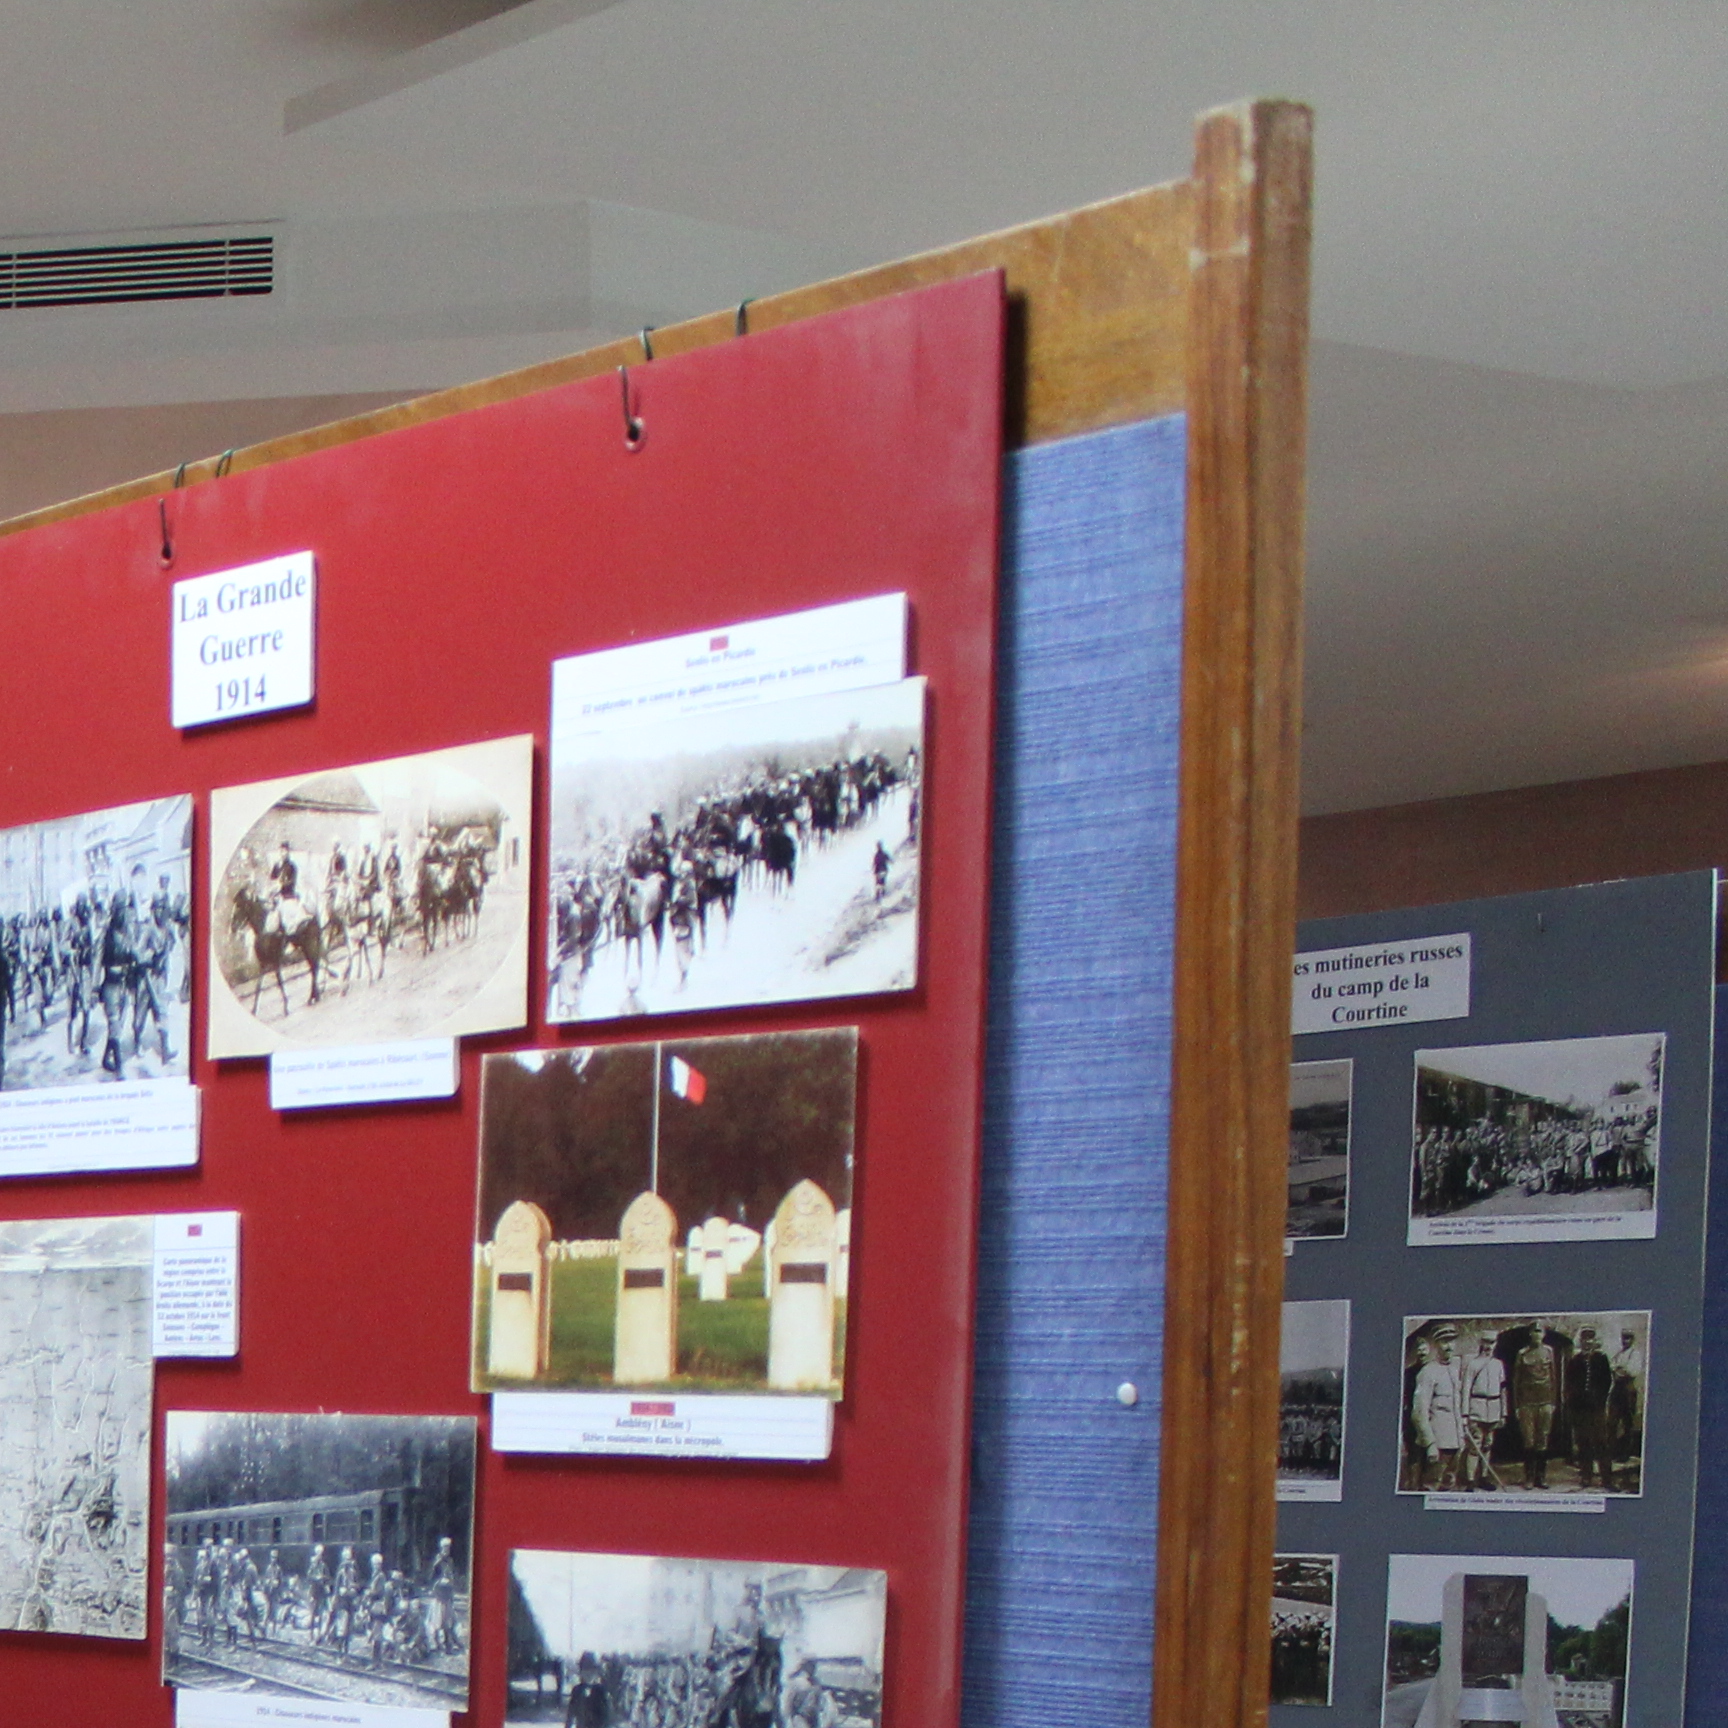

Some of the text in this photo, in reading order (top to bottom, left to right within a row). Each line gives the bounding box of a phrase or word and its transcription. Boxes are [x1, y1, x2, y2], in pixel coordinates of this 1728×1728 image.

[179, 569, 307, 623] La Grande
[199, 629, 284, 666] Guerre
[215, 673, 267, 712] 1914
[1294, 943, 1463, 976] es mutineries russes
[1311, 972, 1430, 1000] du camp de la
[1332, 1002, 1408, 1024] Courtine
